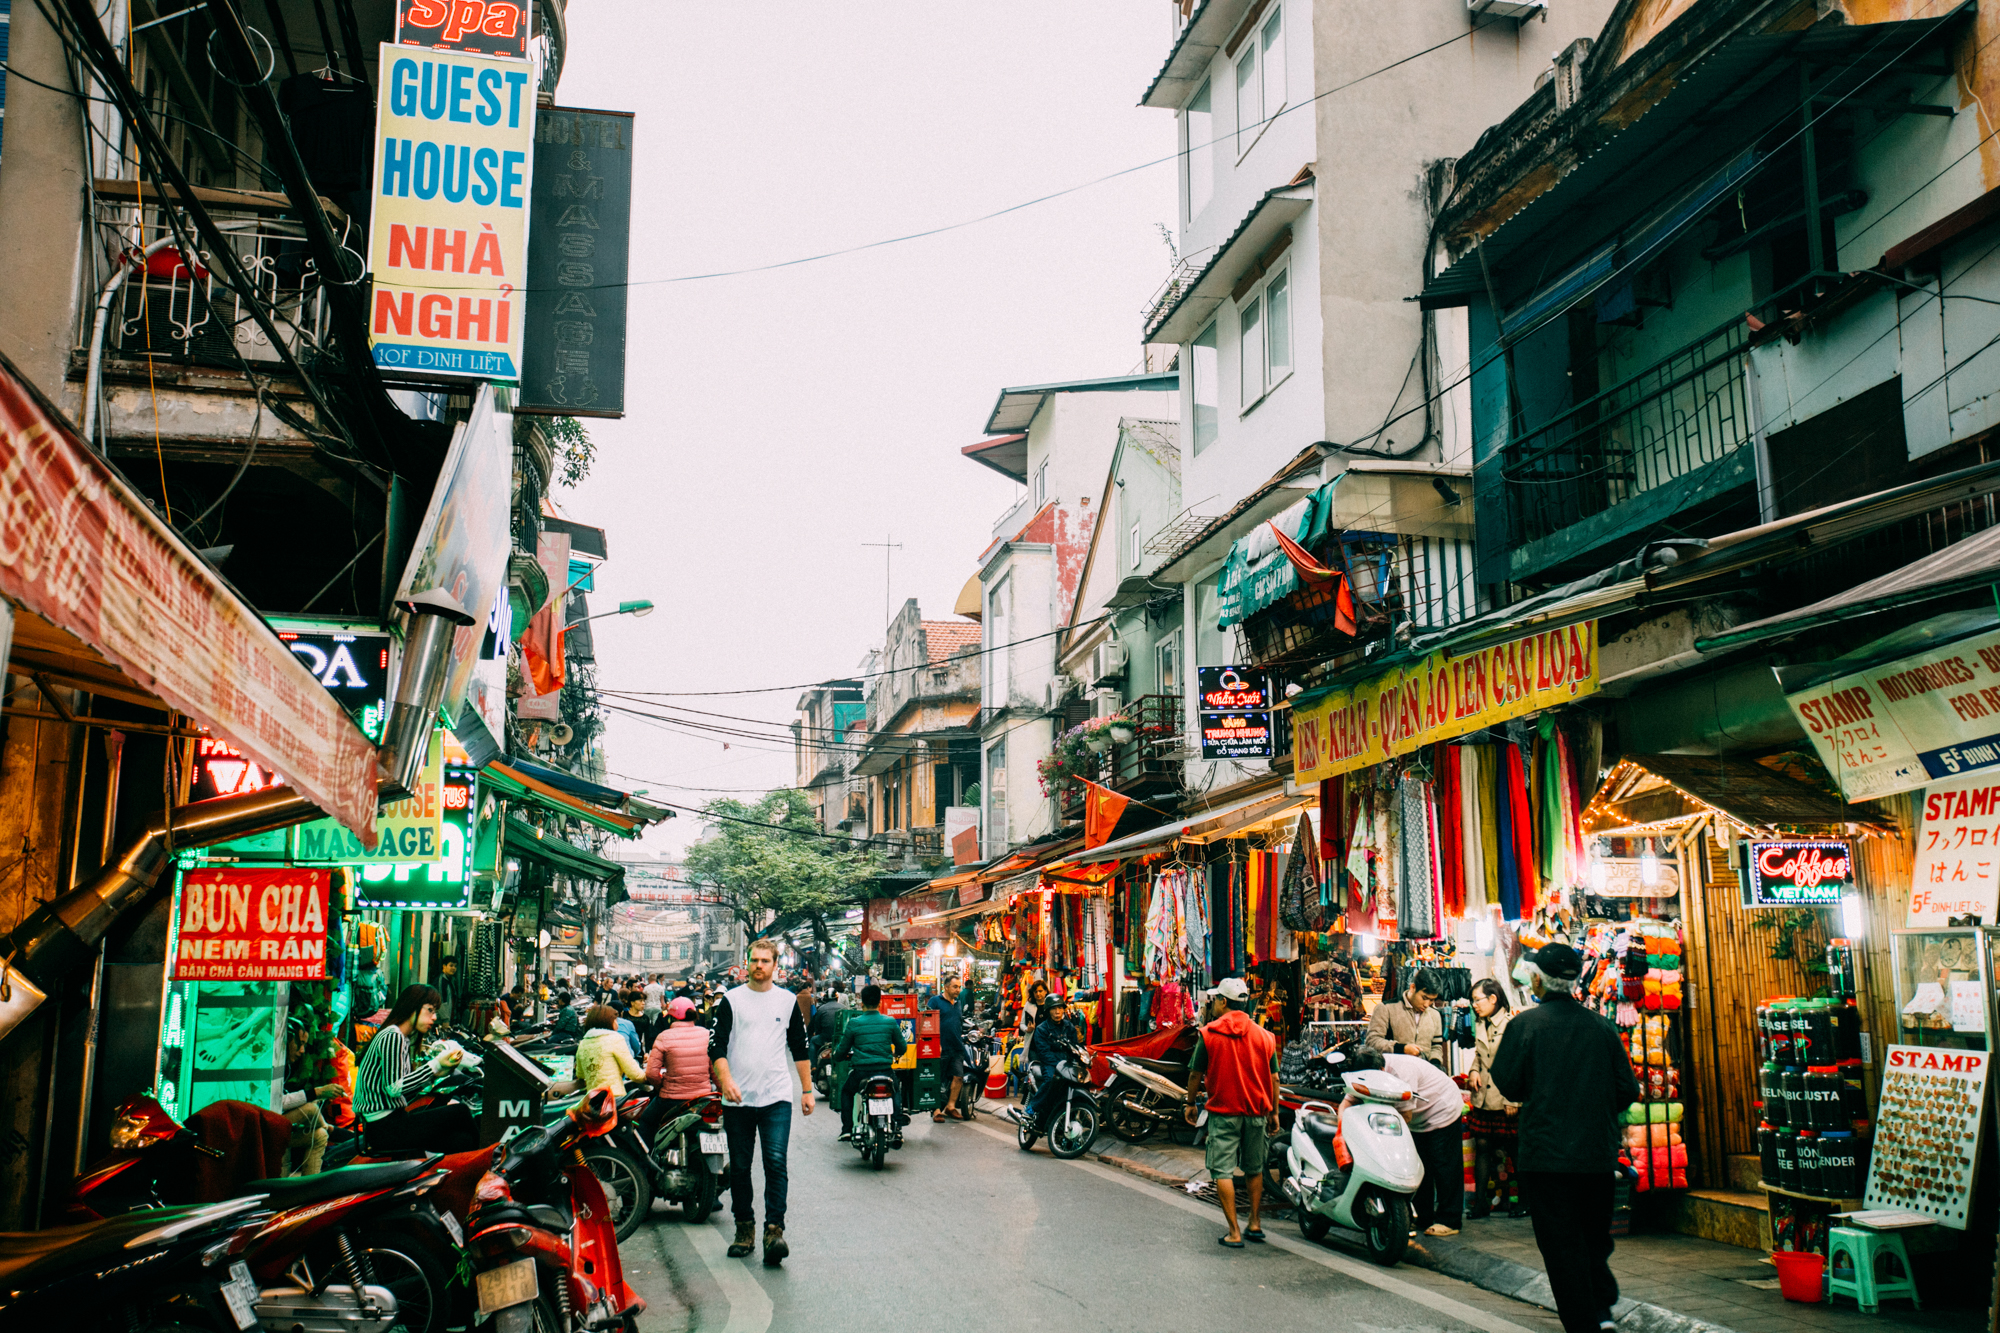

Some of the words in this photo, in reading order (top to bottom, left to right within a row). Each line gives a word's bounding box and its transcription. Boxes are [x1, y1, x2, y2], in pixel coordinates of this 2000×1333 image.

[407, 0, 520, 42] Spa
[390, 57, 528, 129] GUEST
[382, 137, 525, 208] HOUSE
[388, 222, 505, 277] NHÀ
[374, 283, 514, 344] NGHỈ
[1453, 650, 1488, 720] LEN
[1876, 656, 1975, 703] MOTORBIKES
[1799, 686, 1875, 734] STAMP
[1949, 693, 1990, 721] FOR
[1841, 746, 1887, 768] はんこ
[304, 827, 434, 858] MASAGE
[1759, 847, 1847, 888] Coffee
[1930, 860, 1991, 883] はんこ
[182, 872, 252, 933] BÚN
[259, 871, 324, 933] CHẢ
[1771, 885, 1804, 899] VIET
[1805, 884, 1840, 898] NAM
[180, 939, 250, 960] NEM
[260, 936, 324, 960] RÁN
[179, 963, 206, 977] BÁN
[209, 962, 234, 978] CHẢ
[266, 965, 304, 977] MANG
[1889, 1050, 1981, 1073] STAMP
